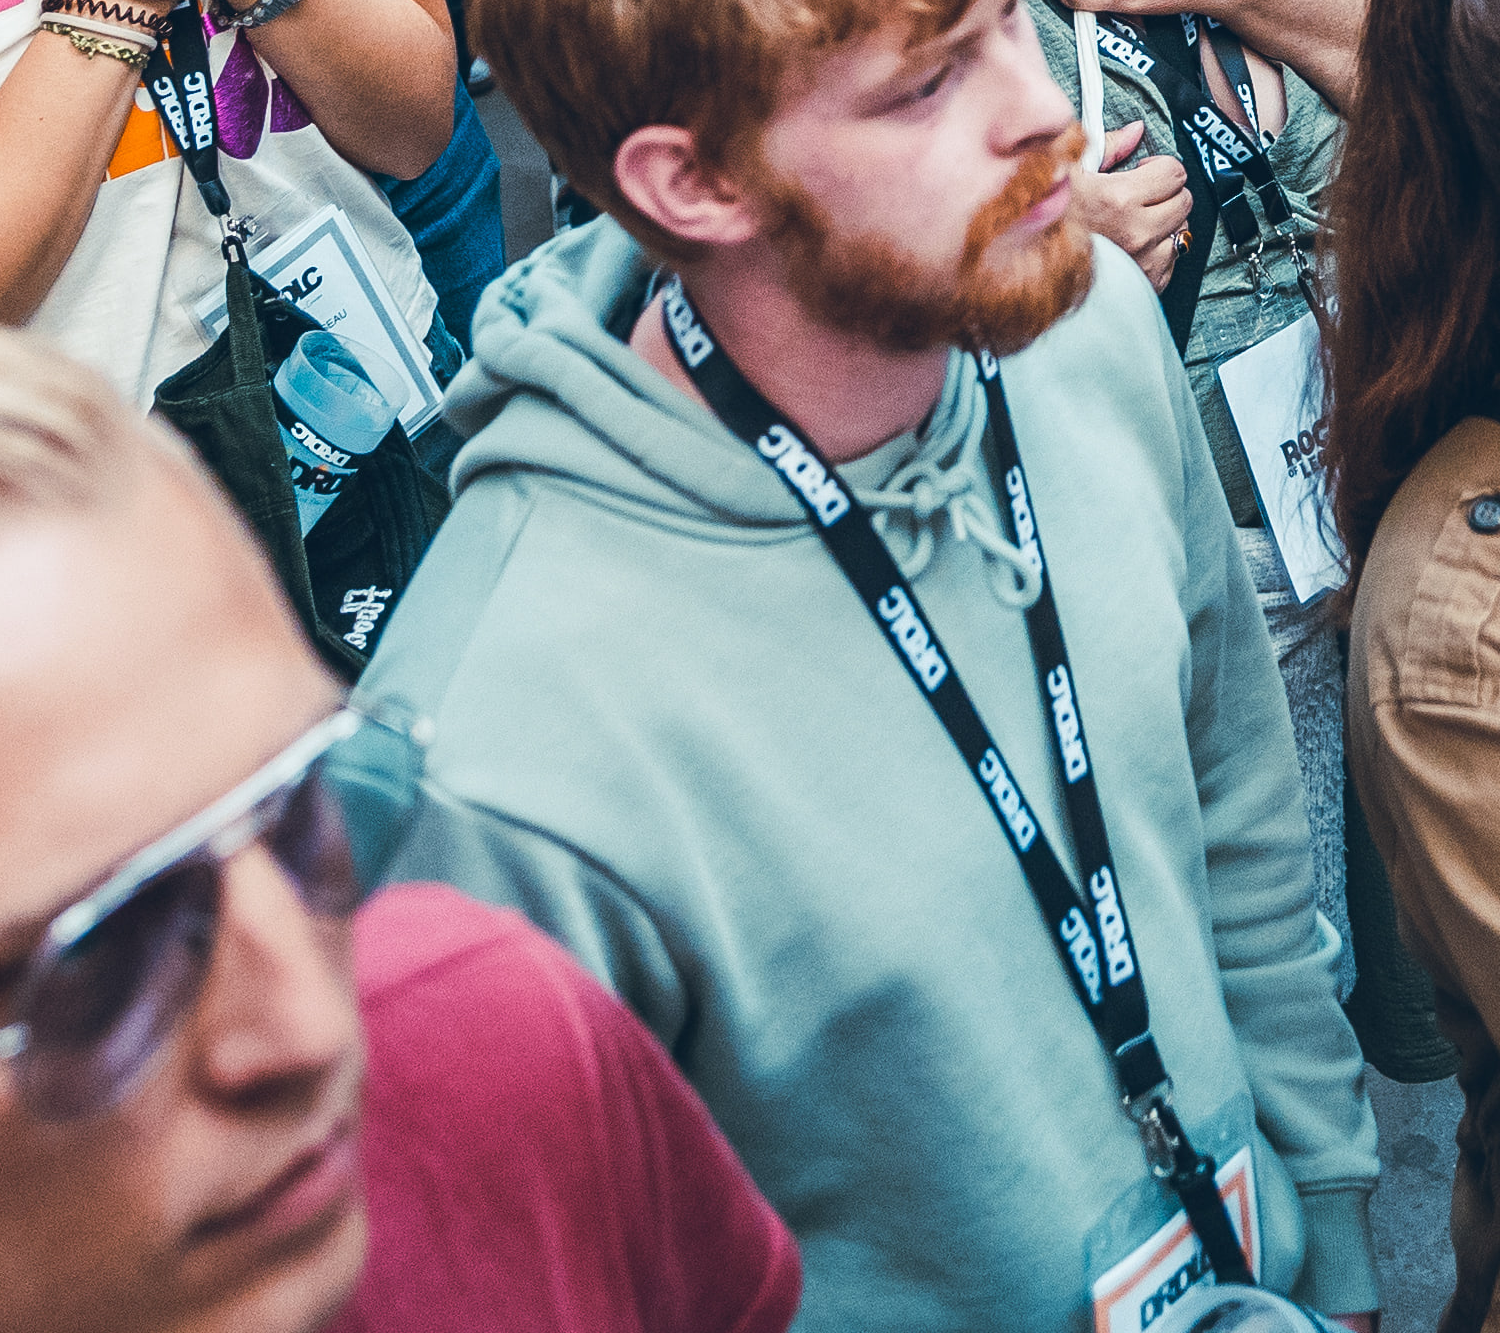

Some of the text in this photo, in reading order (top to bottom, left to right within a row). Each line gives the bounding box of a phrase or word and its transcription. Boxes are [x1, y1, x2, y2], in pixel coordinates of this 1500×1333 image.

[184, 71, 213, 151] DRDLC
[1193, 104, 1254, 165] DRDLC
[290, 421, 352, 468] DRDLC
[757, 423, 852, 528] DRDLC
[876, 584, 949, 693] DRDLC
[1046, 663, 1089, 783] DRDLC
[977, 747, 1038, 853] DRDLC
[1089, 864, 1135, 988] DRDLC
